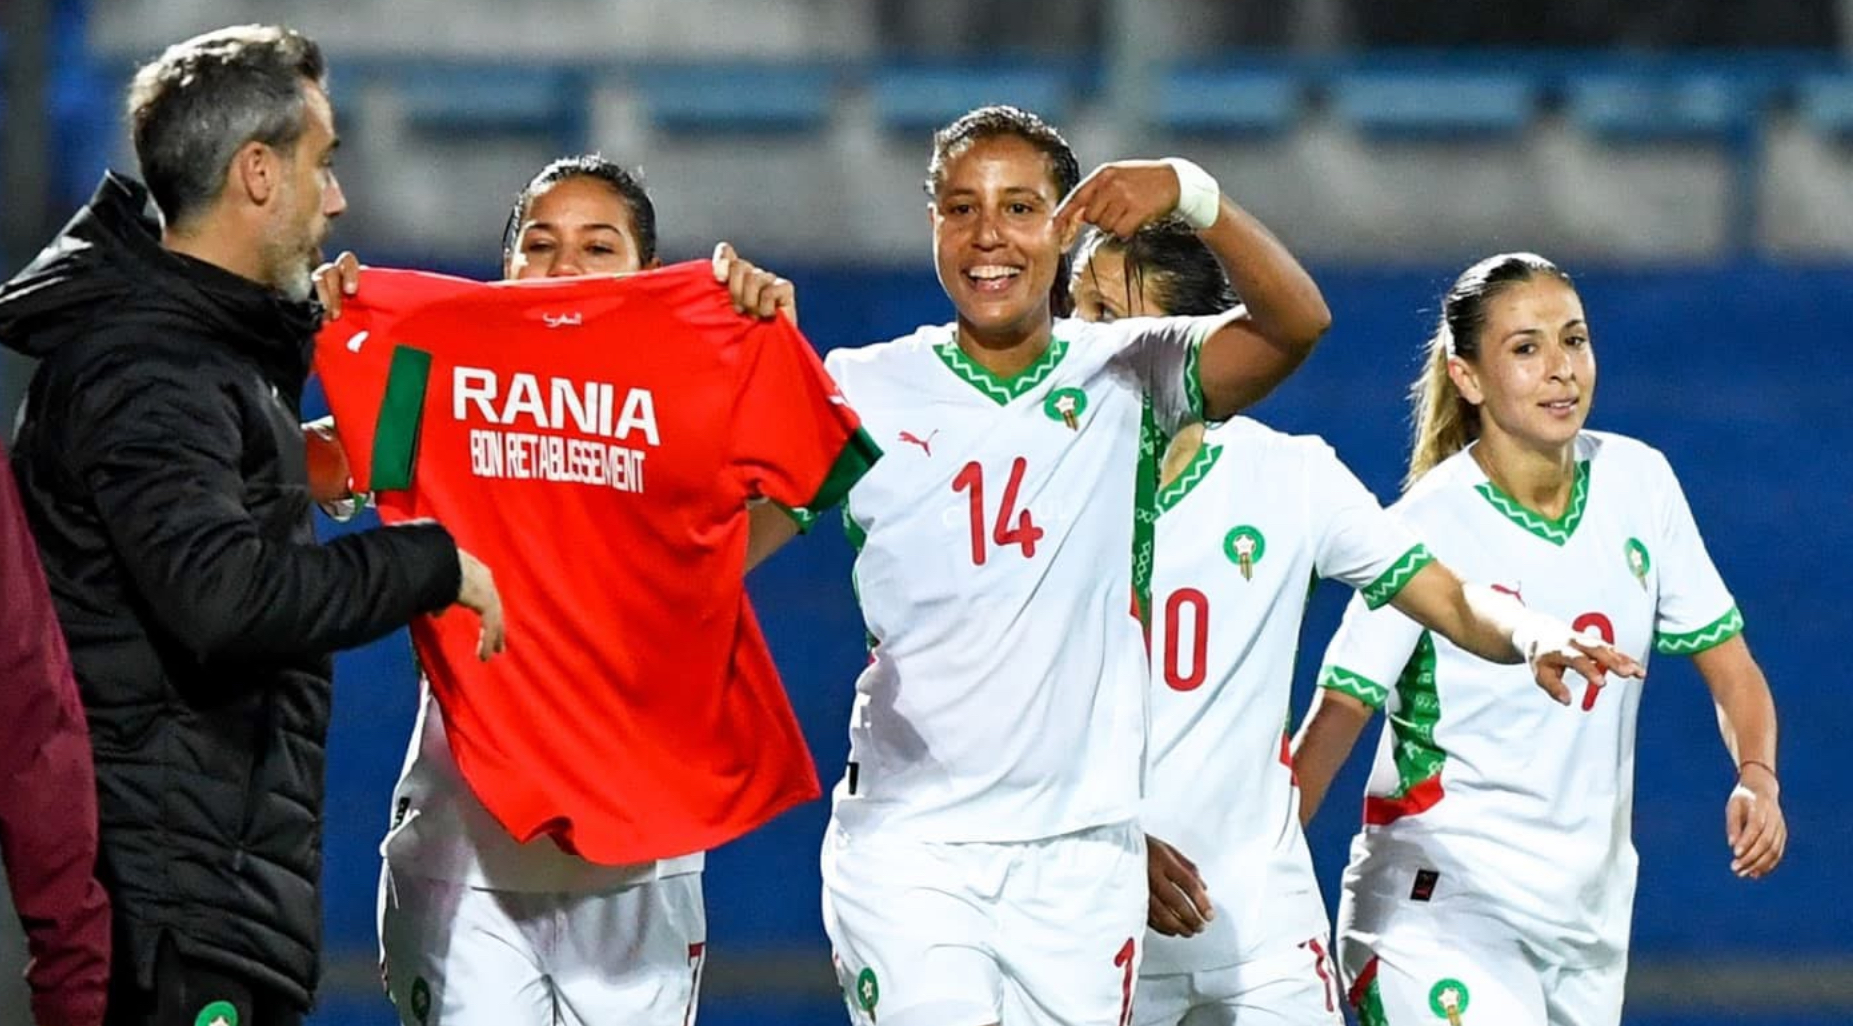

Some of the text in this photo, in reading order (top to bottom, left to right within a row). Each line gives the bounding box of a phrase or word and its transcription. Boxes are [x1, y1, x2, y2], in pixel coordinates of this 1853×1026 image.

[453, 366, 660, 446] RANIA
[470, 429, 503, 478] BON
[952, 456, 1044, 566] 14
